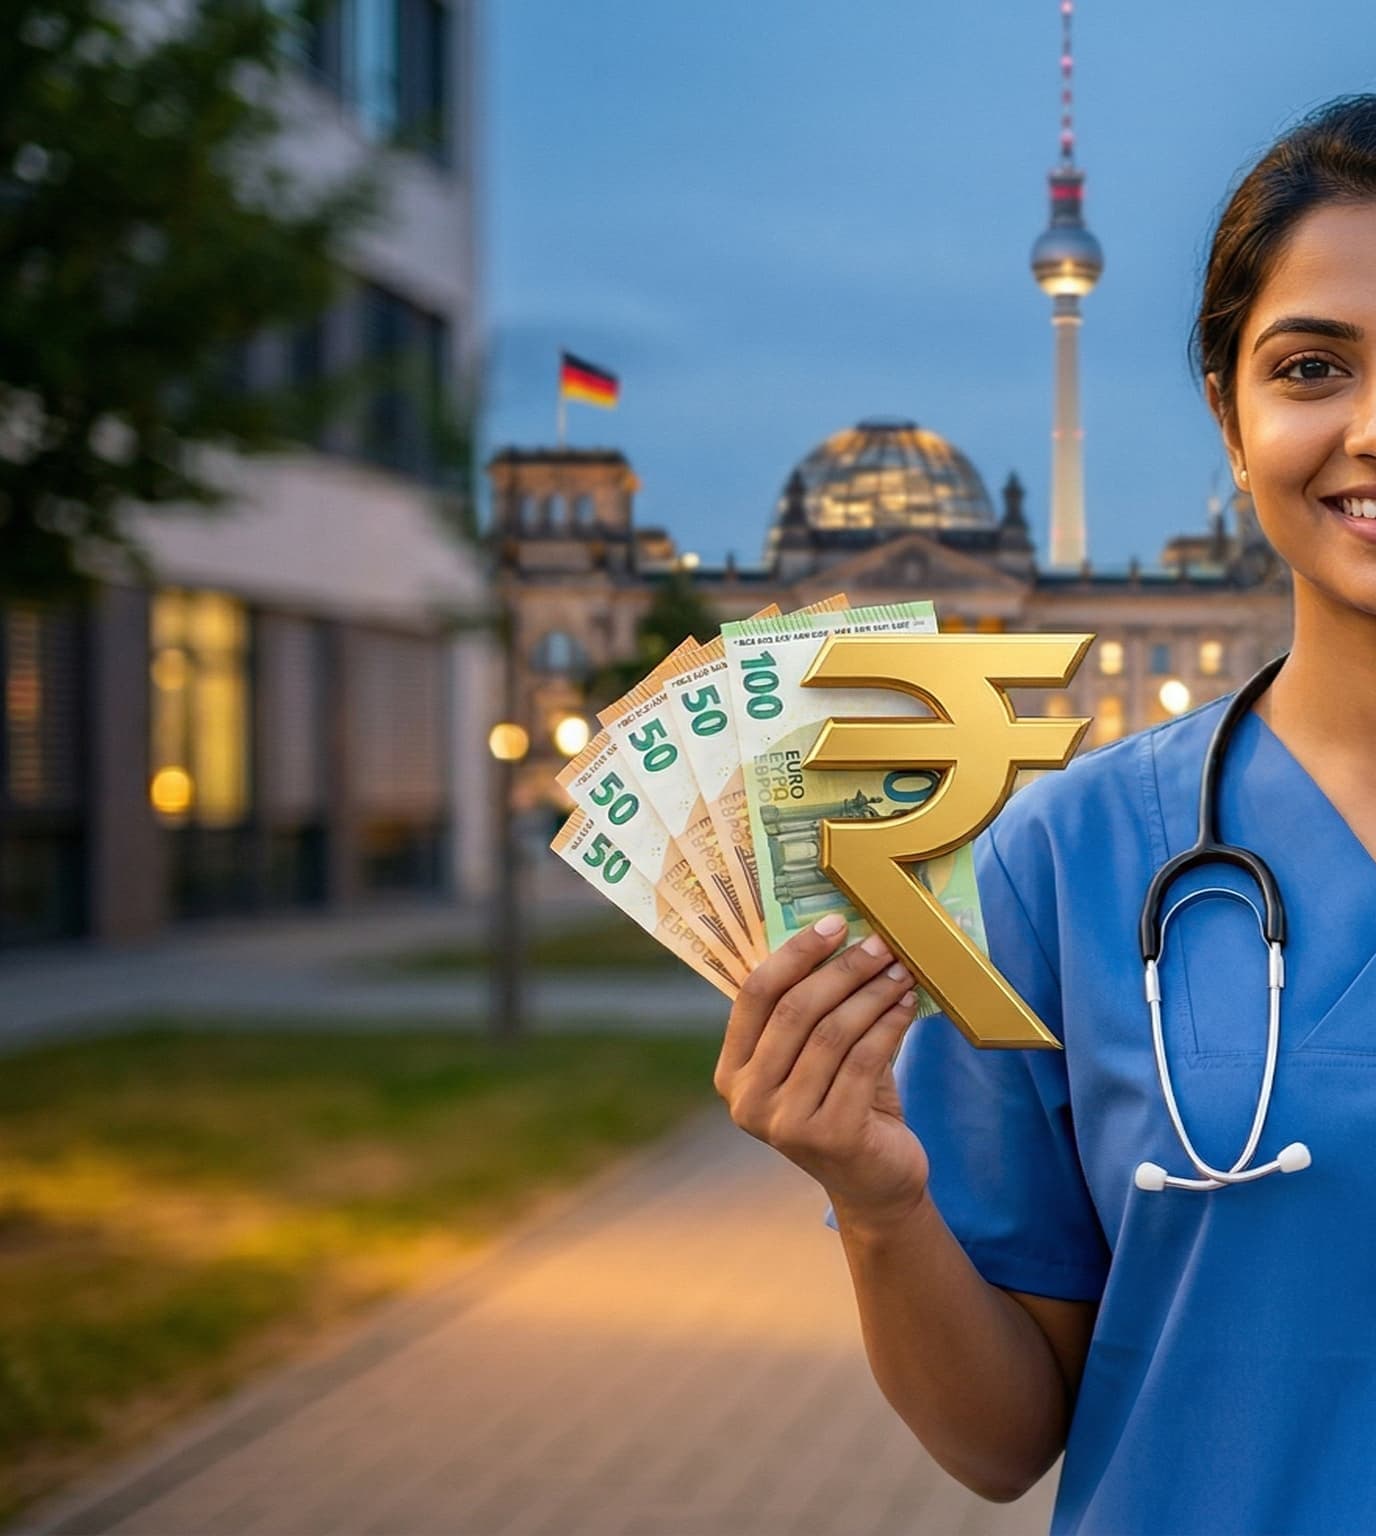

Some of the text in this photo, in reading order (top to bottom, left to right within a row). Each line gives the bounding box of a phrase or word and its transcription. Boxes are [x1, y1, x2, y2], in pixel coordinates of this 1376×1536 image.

[681, 684, 728, 736] 50
[740, 650, 784, 720] 100
[628, 718, 678, 772] 50
[589, 771, 639, 825] 50
[785, 750, 805, 800] EURO
[583, 832, 631, 884] 50
